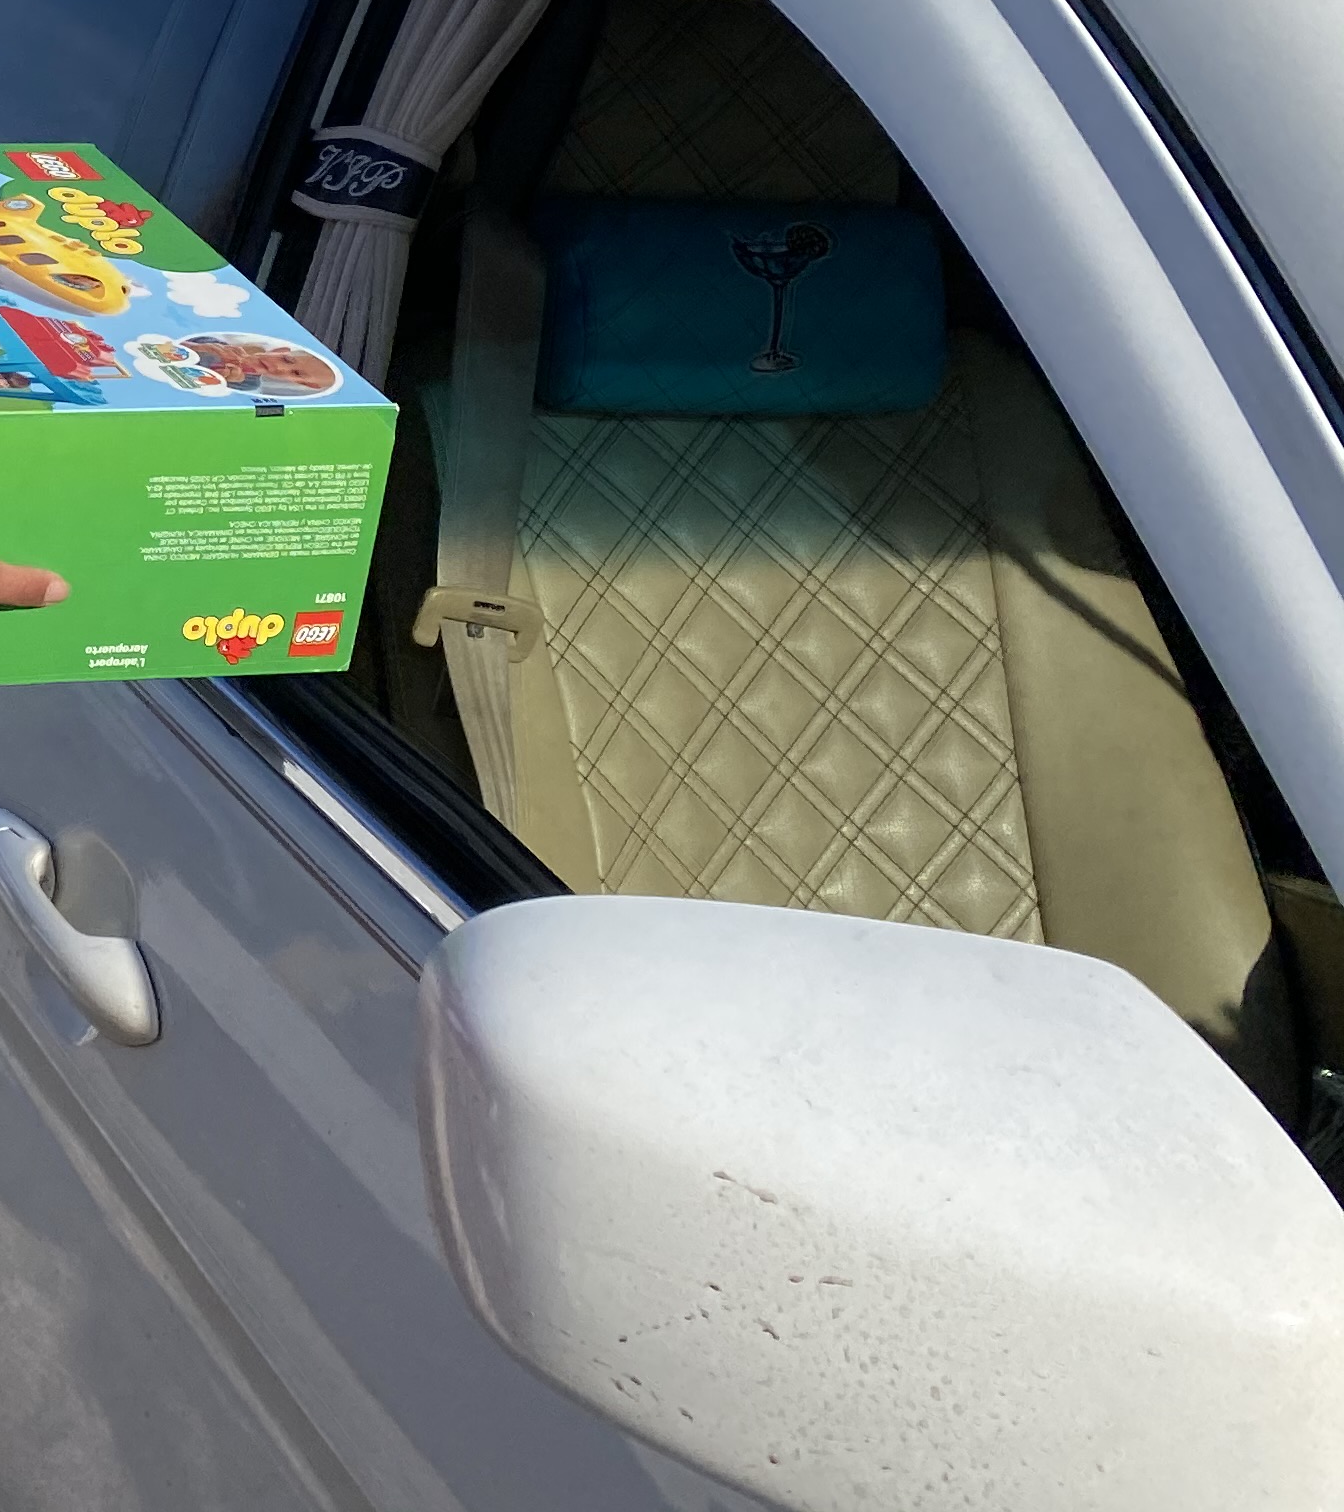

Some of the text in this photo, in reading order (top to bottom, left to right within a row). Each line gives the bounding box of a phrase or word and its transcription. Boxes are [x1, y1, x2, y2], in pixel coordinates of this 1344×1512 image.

[26, 152, 81, 180] LEGO
[47, 187, 145, 255] duplo
[315, 592, 347, 603] 10871
[182, 607, 340, 647] LEGO duplo
[85, 643, 149, 656] Aeropuerto
